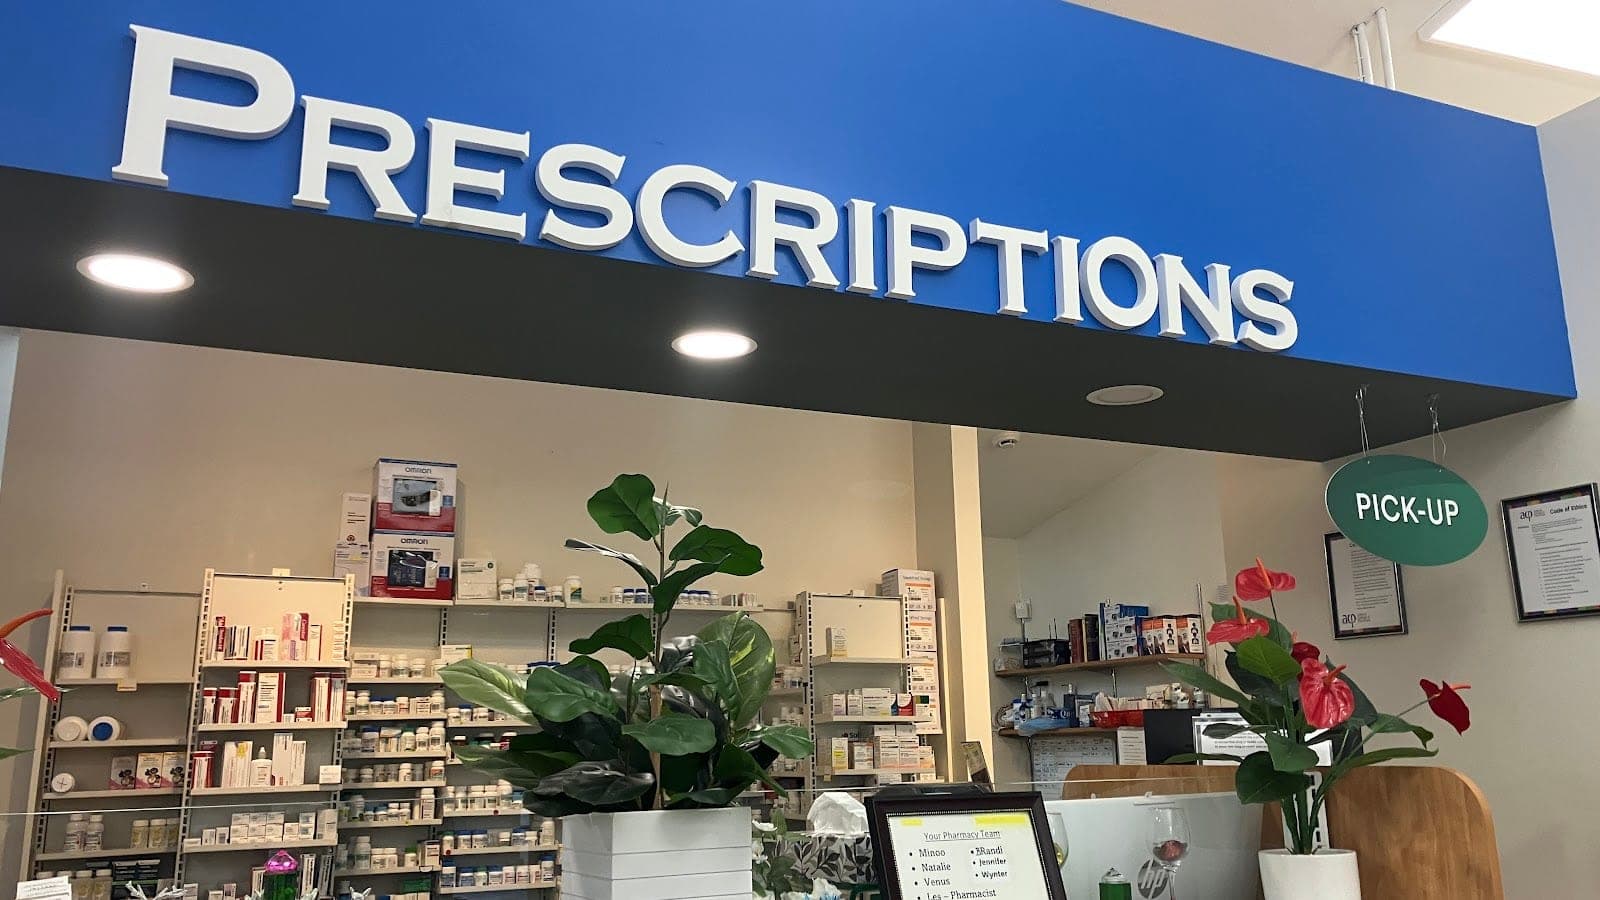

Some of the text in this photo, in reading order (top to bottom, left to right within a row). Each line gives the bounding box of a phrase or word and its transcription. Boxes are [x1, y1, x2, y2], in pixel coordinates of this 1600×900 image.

[111, 23, 1298, 353] PRESCRIPTIONS
[1355, 492, 1459, 526] PICK-UP
[923, 830, 1001, 841] Your Pharmacy Team
[919, 848, 946, 858] Minoo
[979, 857, 1007, 867] Jennifer
[921, 863, 951, 873] Natalie
[981, 870, 1008, 880] Wynter
[1140, 858, 1167, 899] hp
[924, 877, 951, 887] Venus
[950, 889, 997, 900] Pharmacist
